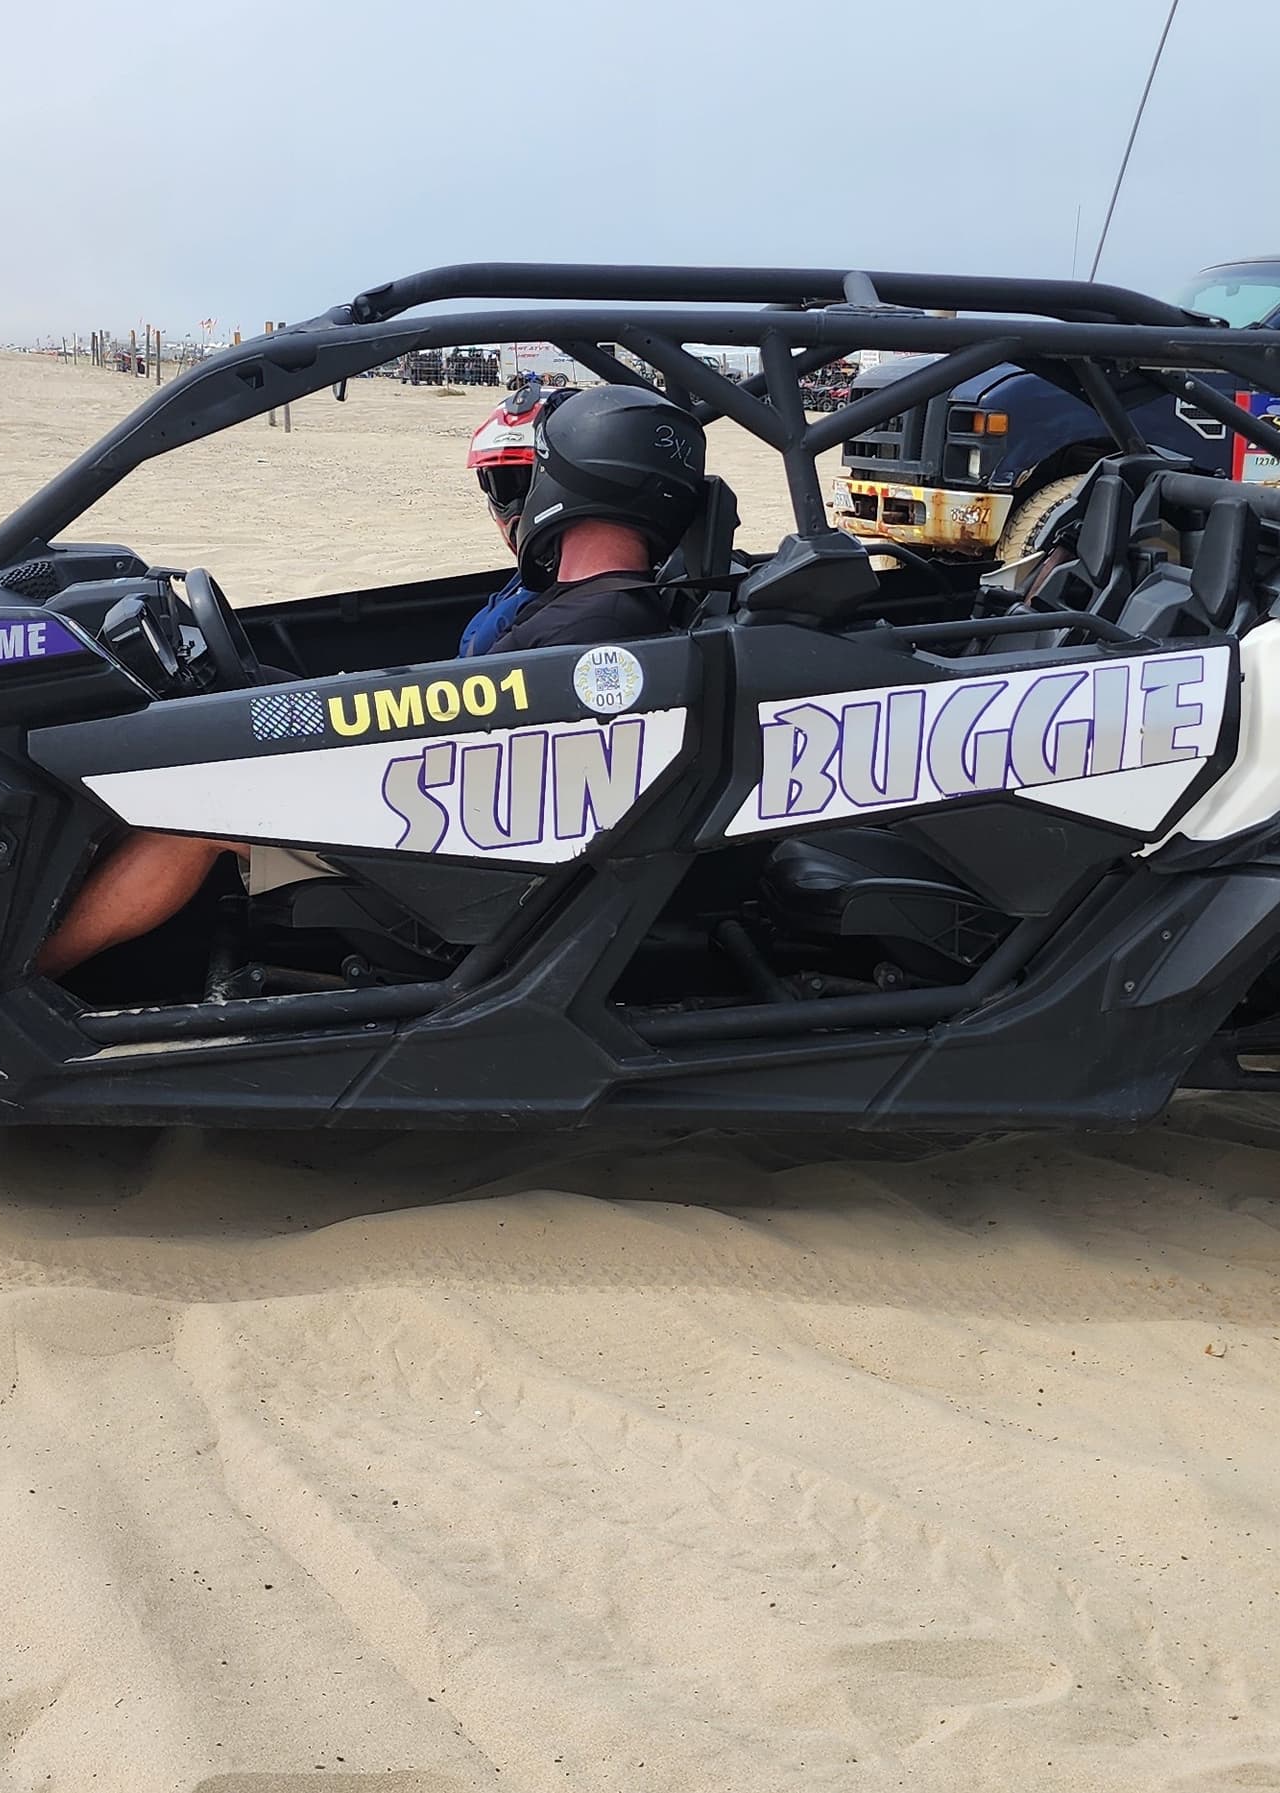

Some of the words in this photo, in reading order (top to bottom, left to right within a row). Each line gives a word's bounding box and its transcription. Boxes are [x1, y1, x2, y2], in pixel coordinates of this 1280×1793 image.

[654, 425, 696, 471] 3XL
[591, 651, 618, 665] UM
[328, 668, 529, 736] UM001
[596, 692, 624, 707] 001
[757, 656, 1204, 819] BUGGIE
[382, 719, 646, 853] SUN
